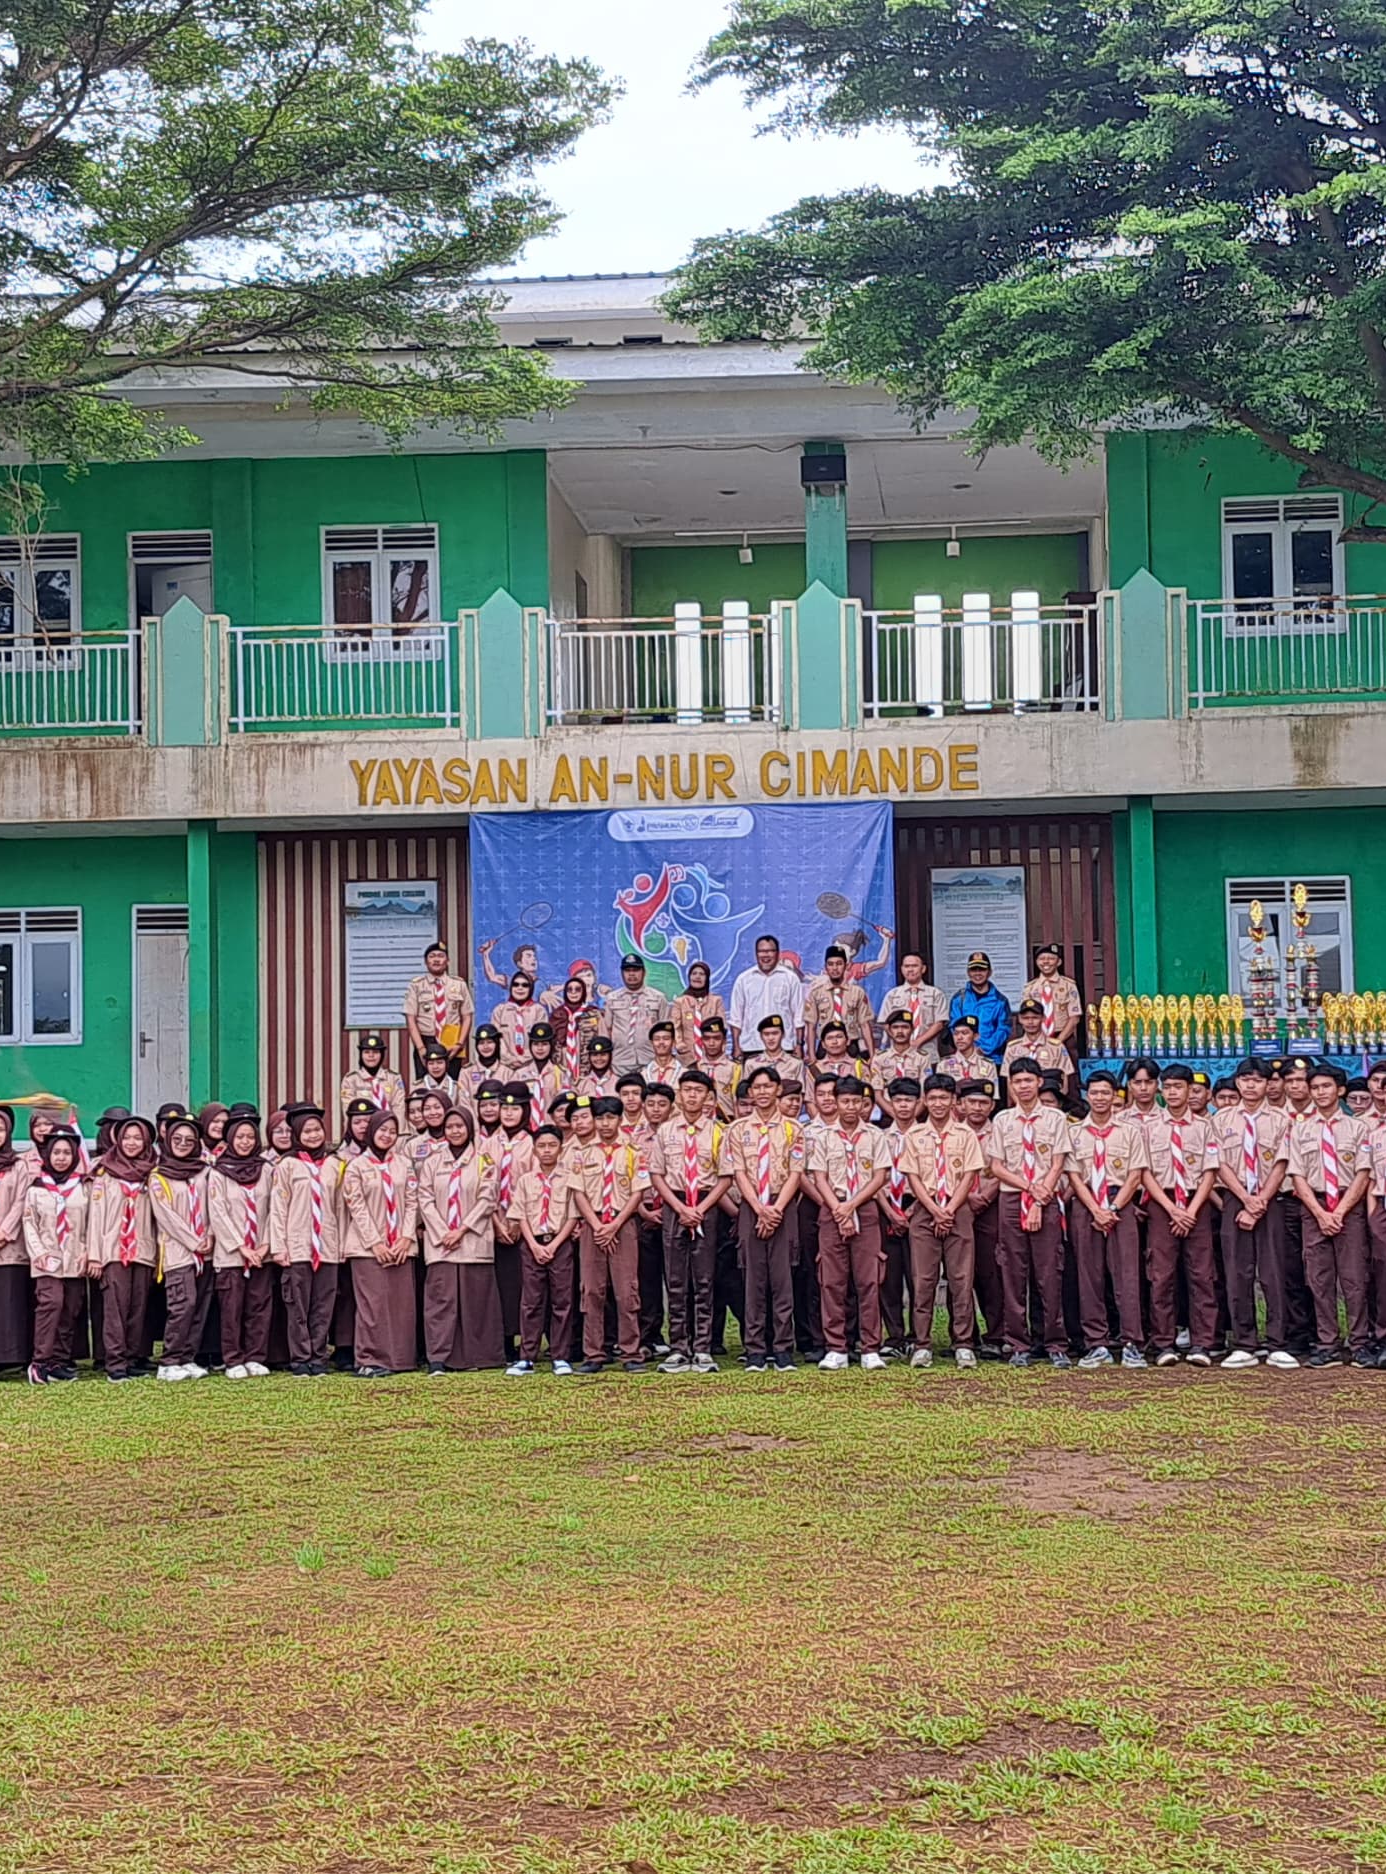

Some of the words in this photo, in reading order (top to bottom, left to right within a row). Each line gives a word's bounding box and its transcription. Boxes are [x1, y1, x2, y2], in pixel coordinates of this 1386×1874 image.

[349, 757, 528, 806] YAYASAN
[549, 753, 737, 803] AN-NUR
[759, 744, 980, 797] CIMANDE
